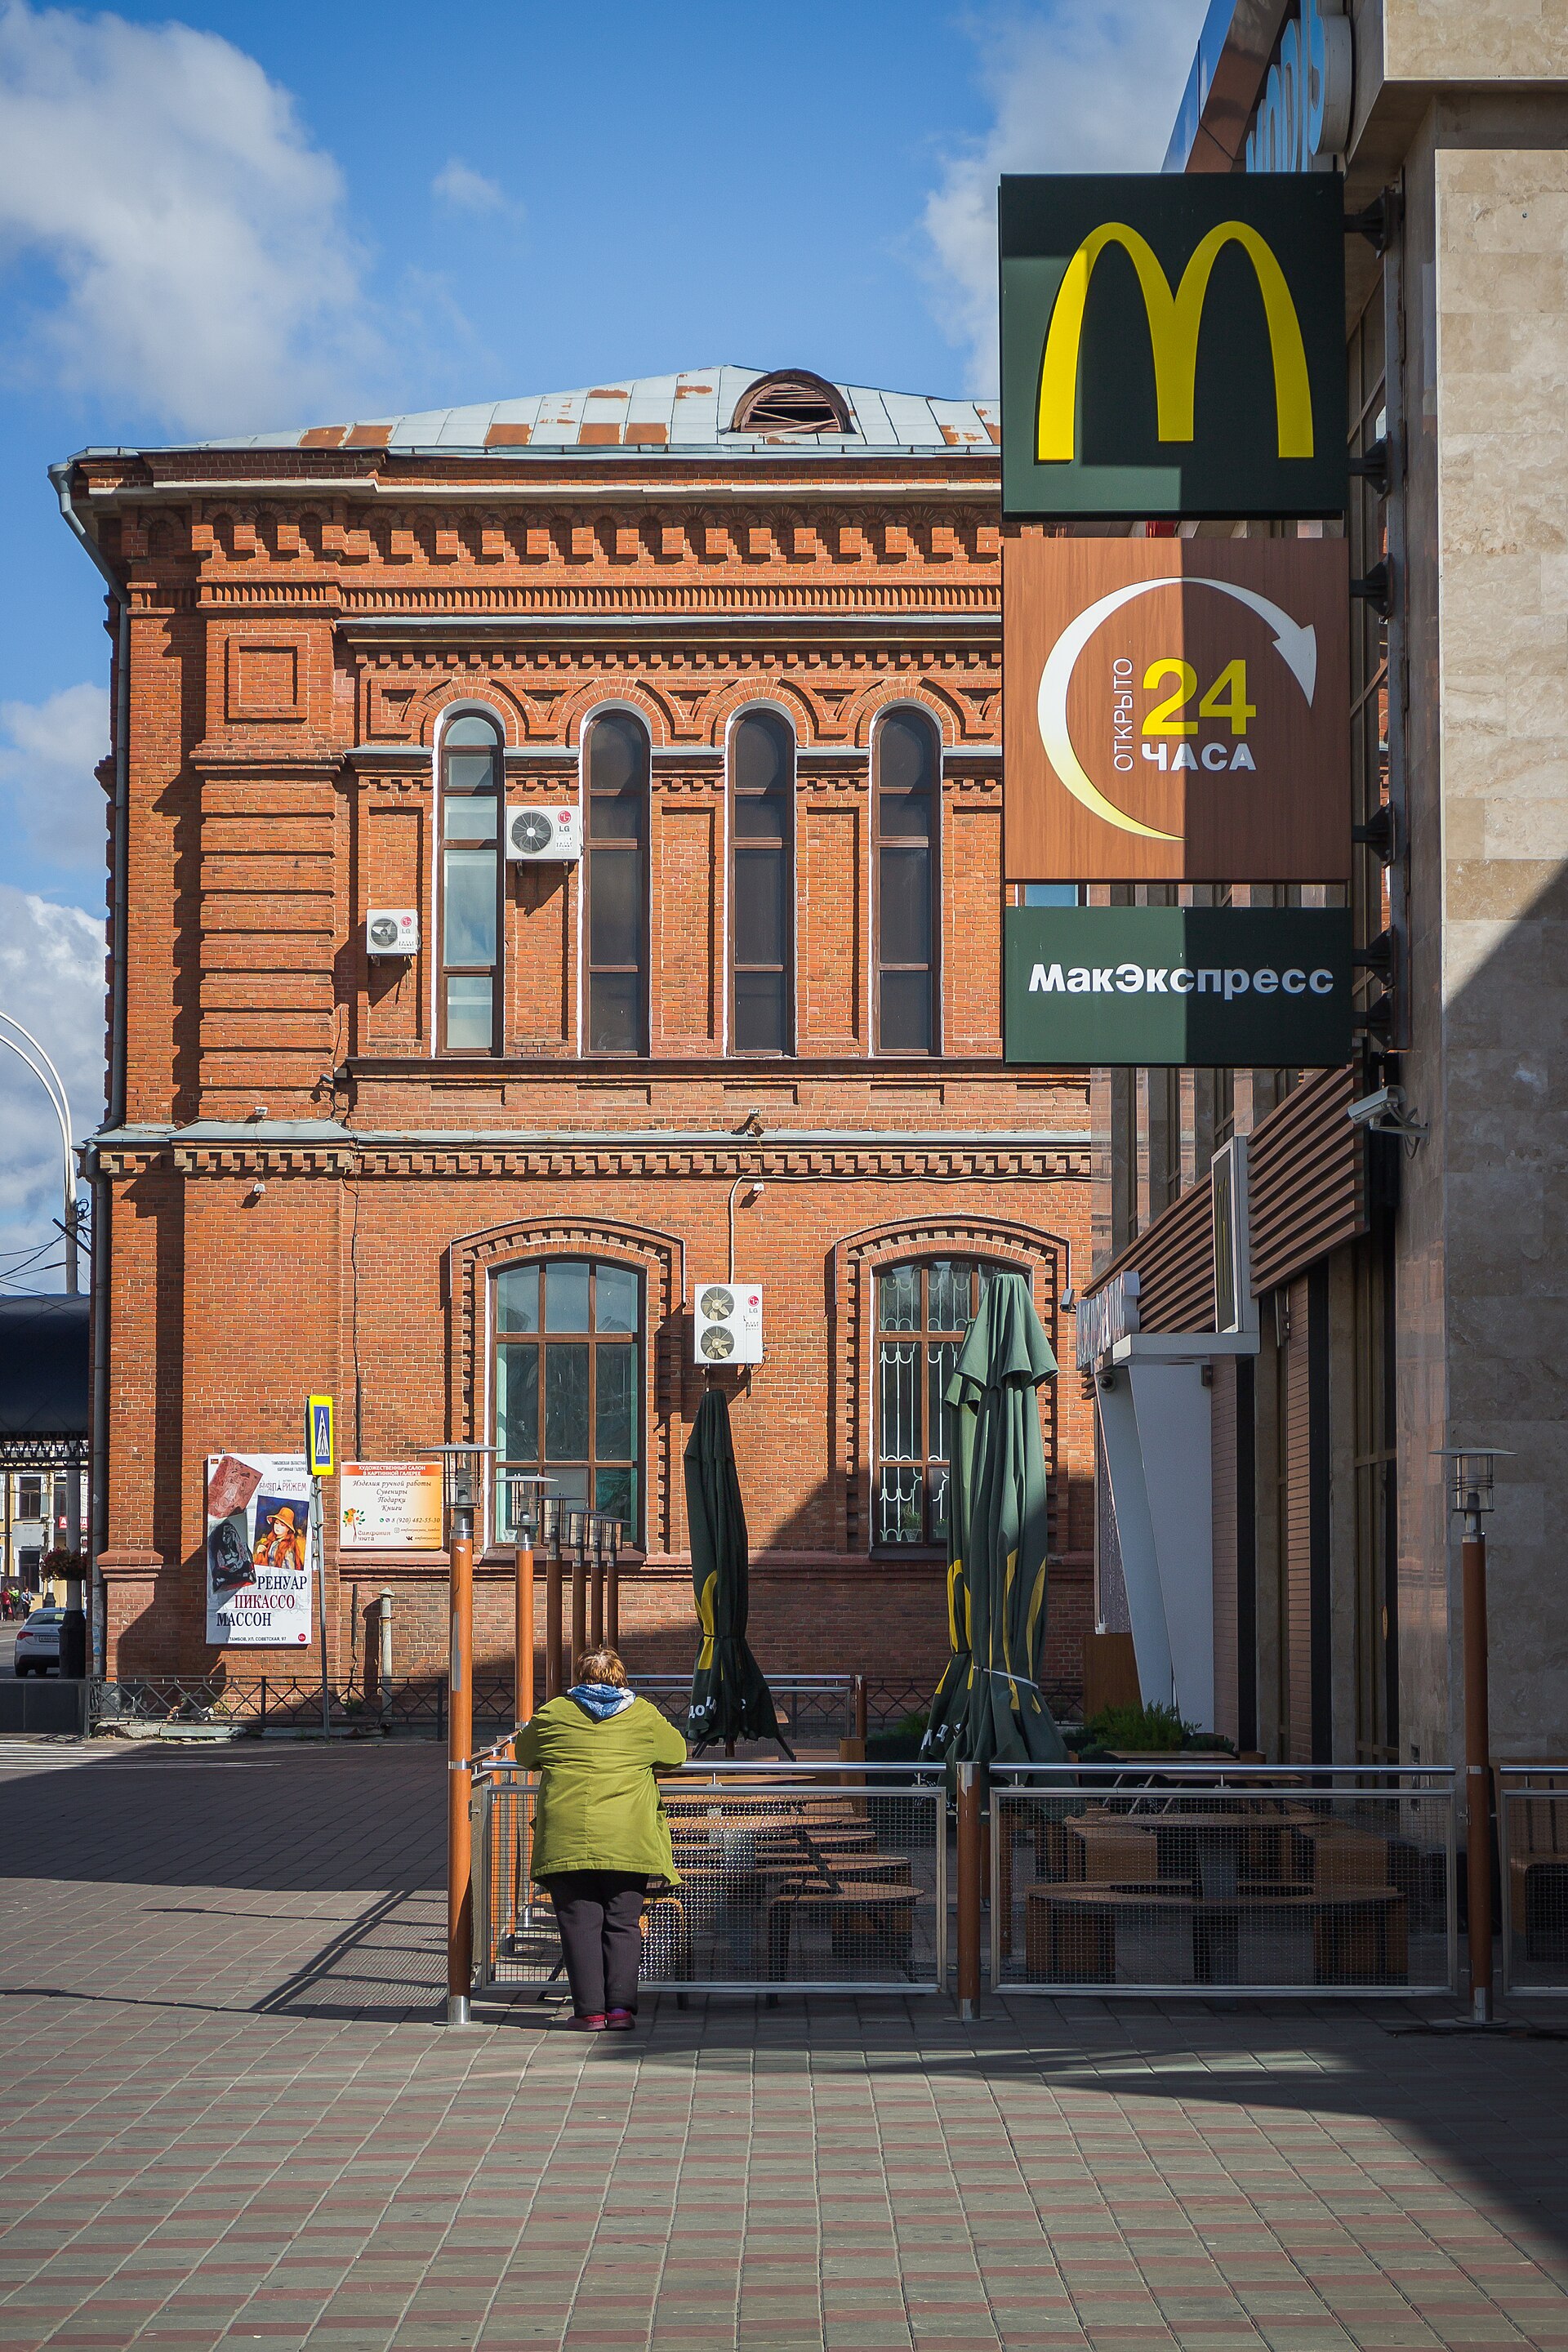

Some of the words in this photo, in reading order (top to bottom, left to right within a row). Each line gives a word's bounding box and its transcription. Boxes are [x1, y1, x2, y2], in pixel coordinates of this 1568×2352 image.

[1141, 657, 1257, 735] 24
[1112, 657, 1134, 772] ОТКРЫТО
[1141, 742, 1257, 772] ЧАСА
[1027, 962, 1334, 1001] МакЭкспресс
[406, 1480, 432, 1488] работы
[376, 1489, 408, 1497] Сувениры
[377, 1496, 406, 1504] Подарки
[256, 1575, 308, 1590] РЕНУАР
[234, 1594, 296, 1609] ПИКАССО
[216, 1612, 272, 1626] МАССОН
